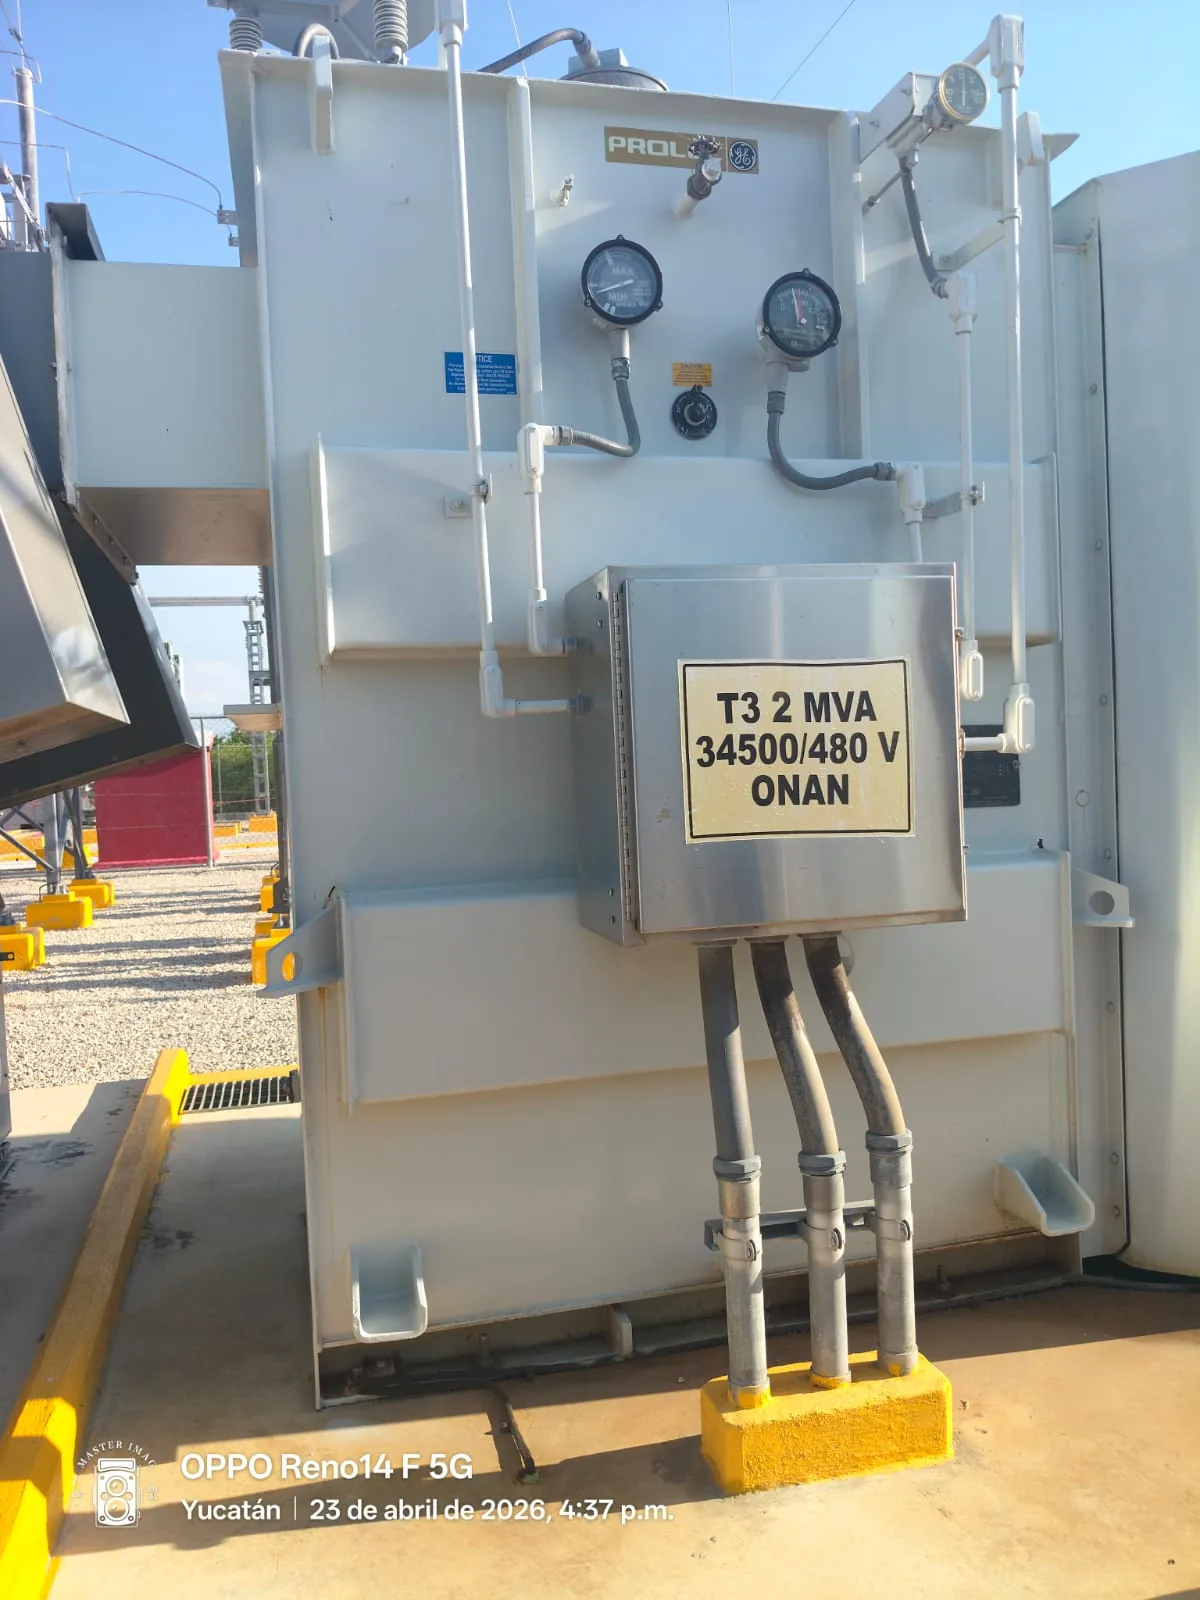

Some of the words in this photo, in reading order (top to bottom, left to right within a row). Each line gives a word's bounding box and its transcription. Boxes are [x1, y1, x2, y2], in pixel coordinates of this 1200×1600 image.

[608, 136, 700, 160] PROL
[608, 293, 628, 302] MIN
[717, 692, 761, 724] T3
[772, 691, 792, 723] 2
[804, 690, 877, 723] MVA
[695, 733, 867, 768] 34500/480
[877, 731, 900, 763] V
[751, 774, 849, 807] ONAN
